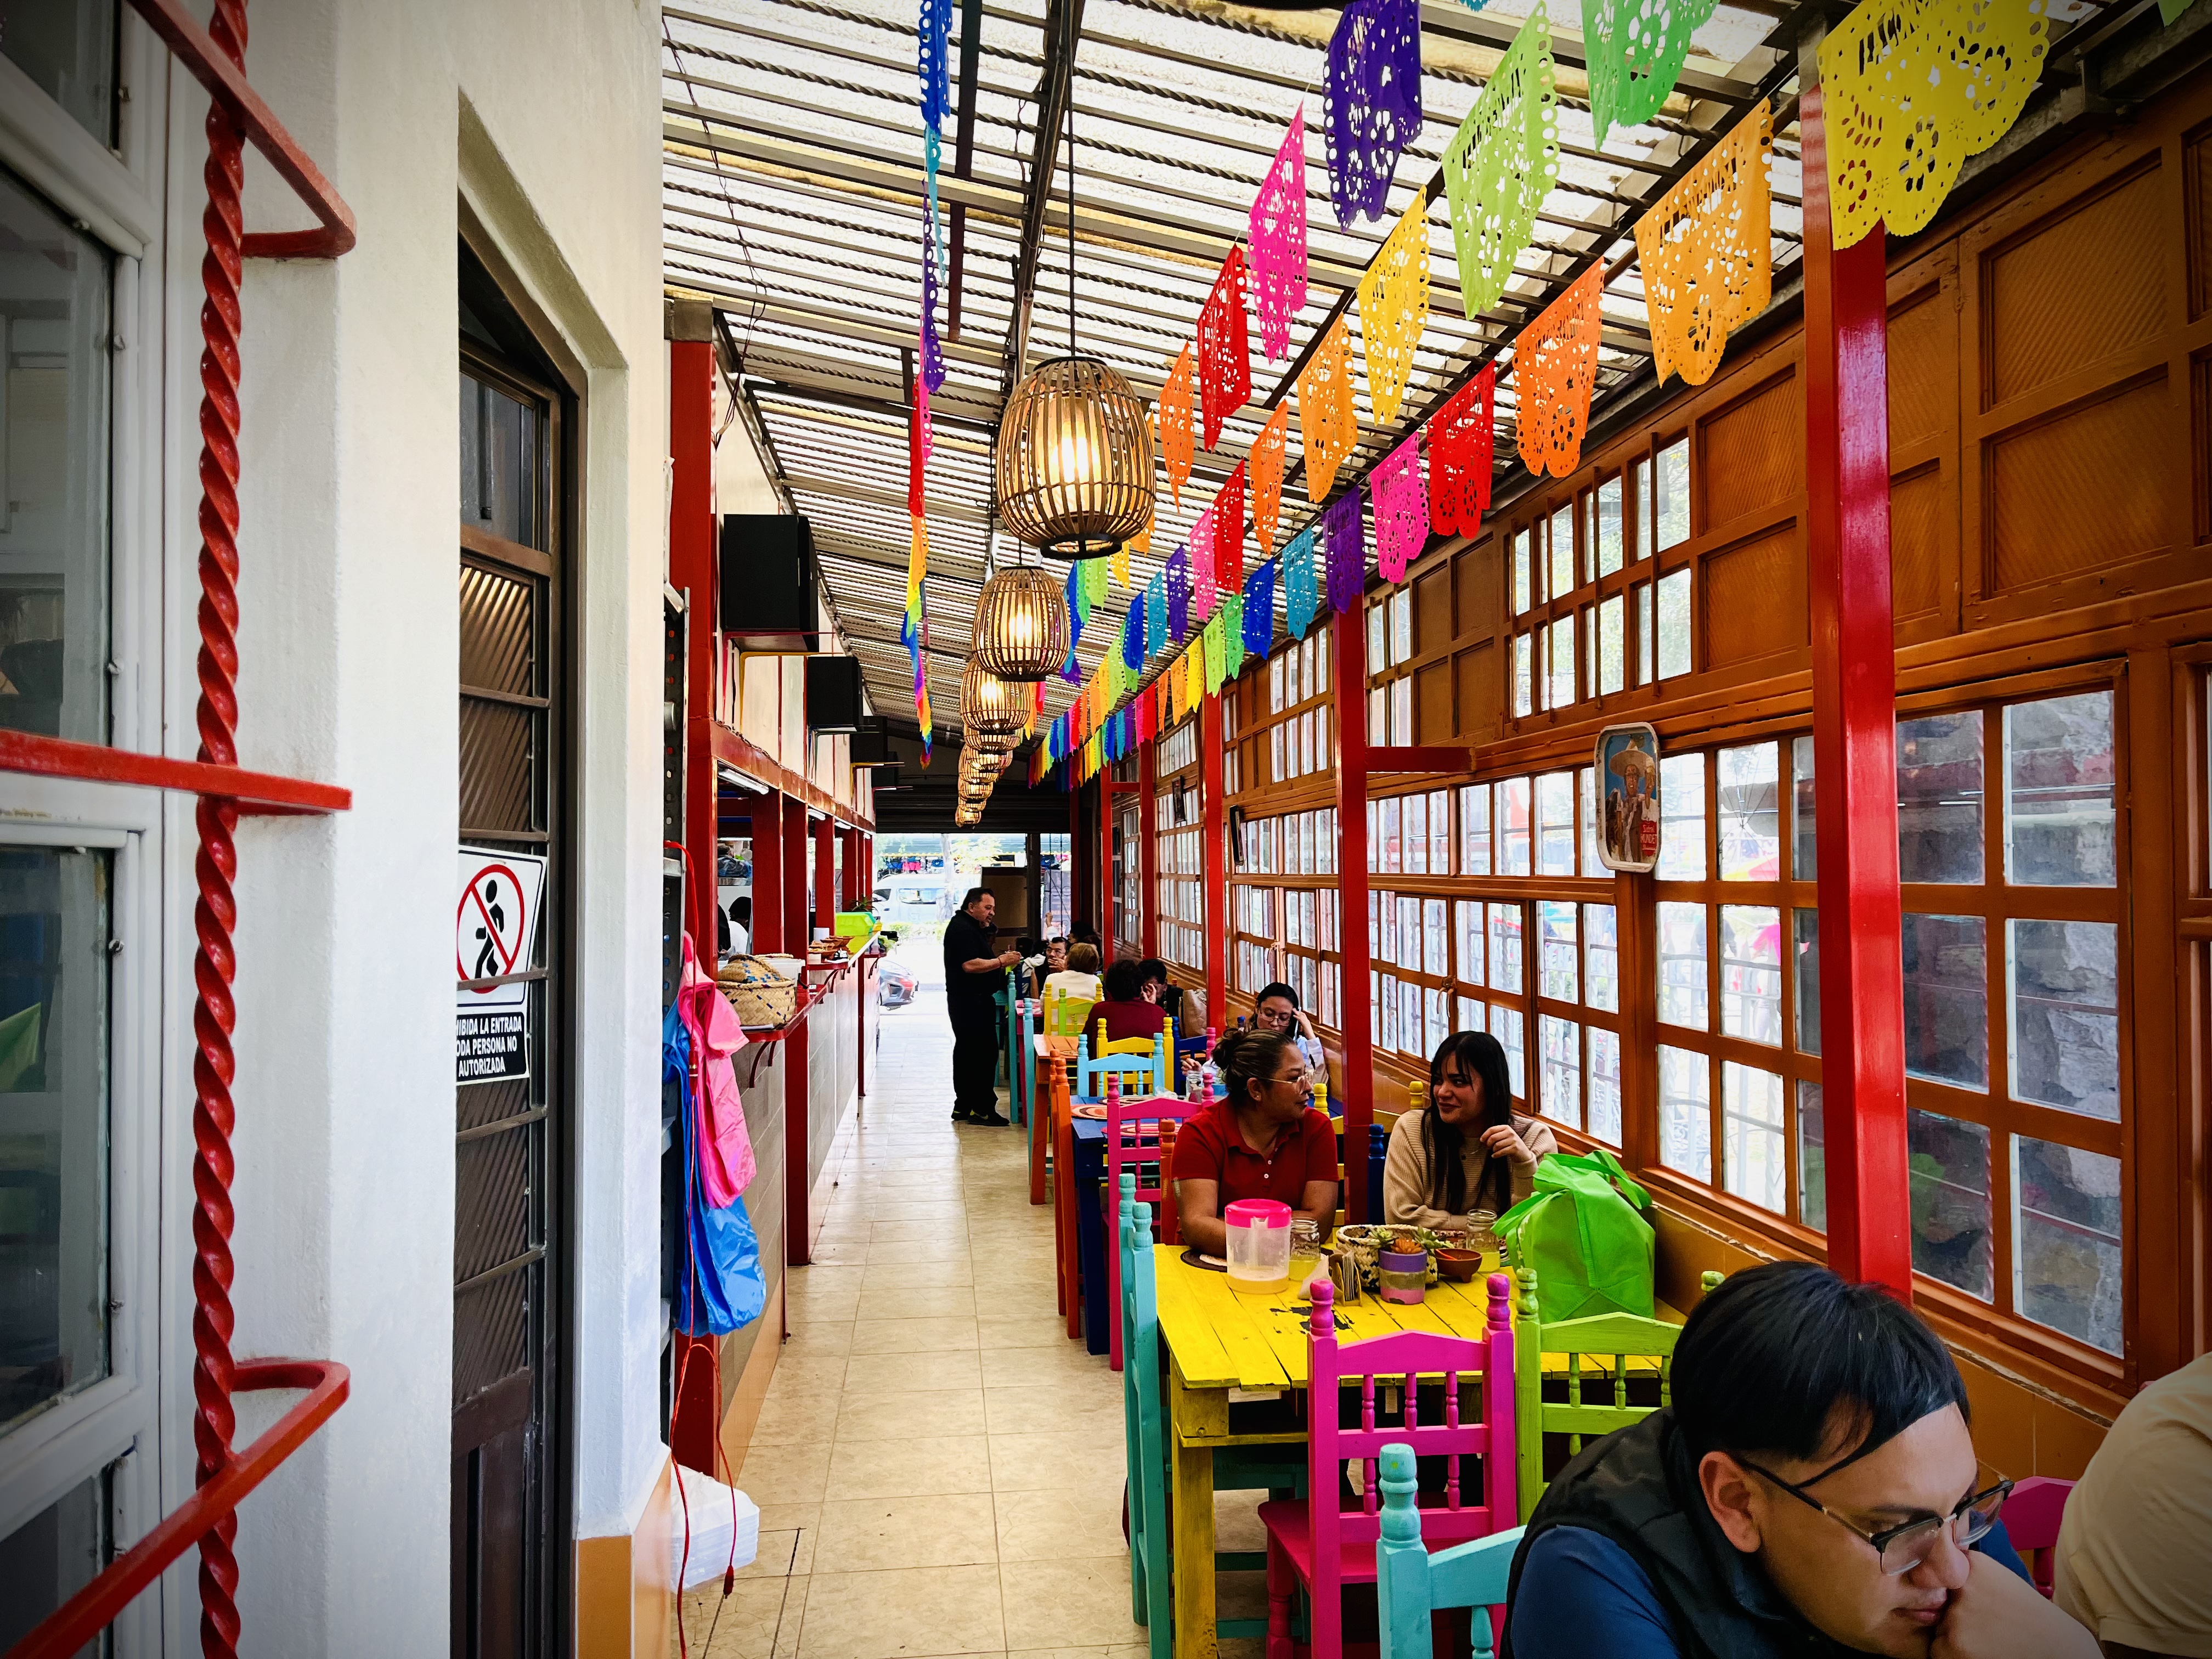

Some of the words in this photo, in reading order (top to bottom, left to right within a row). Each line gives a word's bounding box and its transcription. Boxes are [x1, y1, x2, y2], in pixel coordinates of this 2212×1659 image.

[479, 1018, 489, 1035] LA
[490, 1016, 522, 1034] ENTRADA
[472, 1036, 506, 1056] PERSONA
[507, 1035, 517, 1052] NO
[458, 1056, 506, 1077] AUTORIZADA
